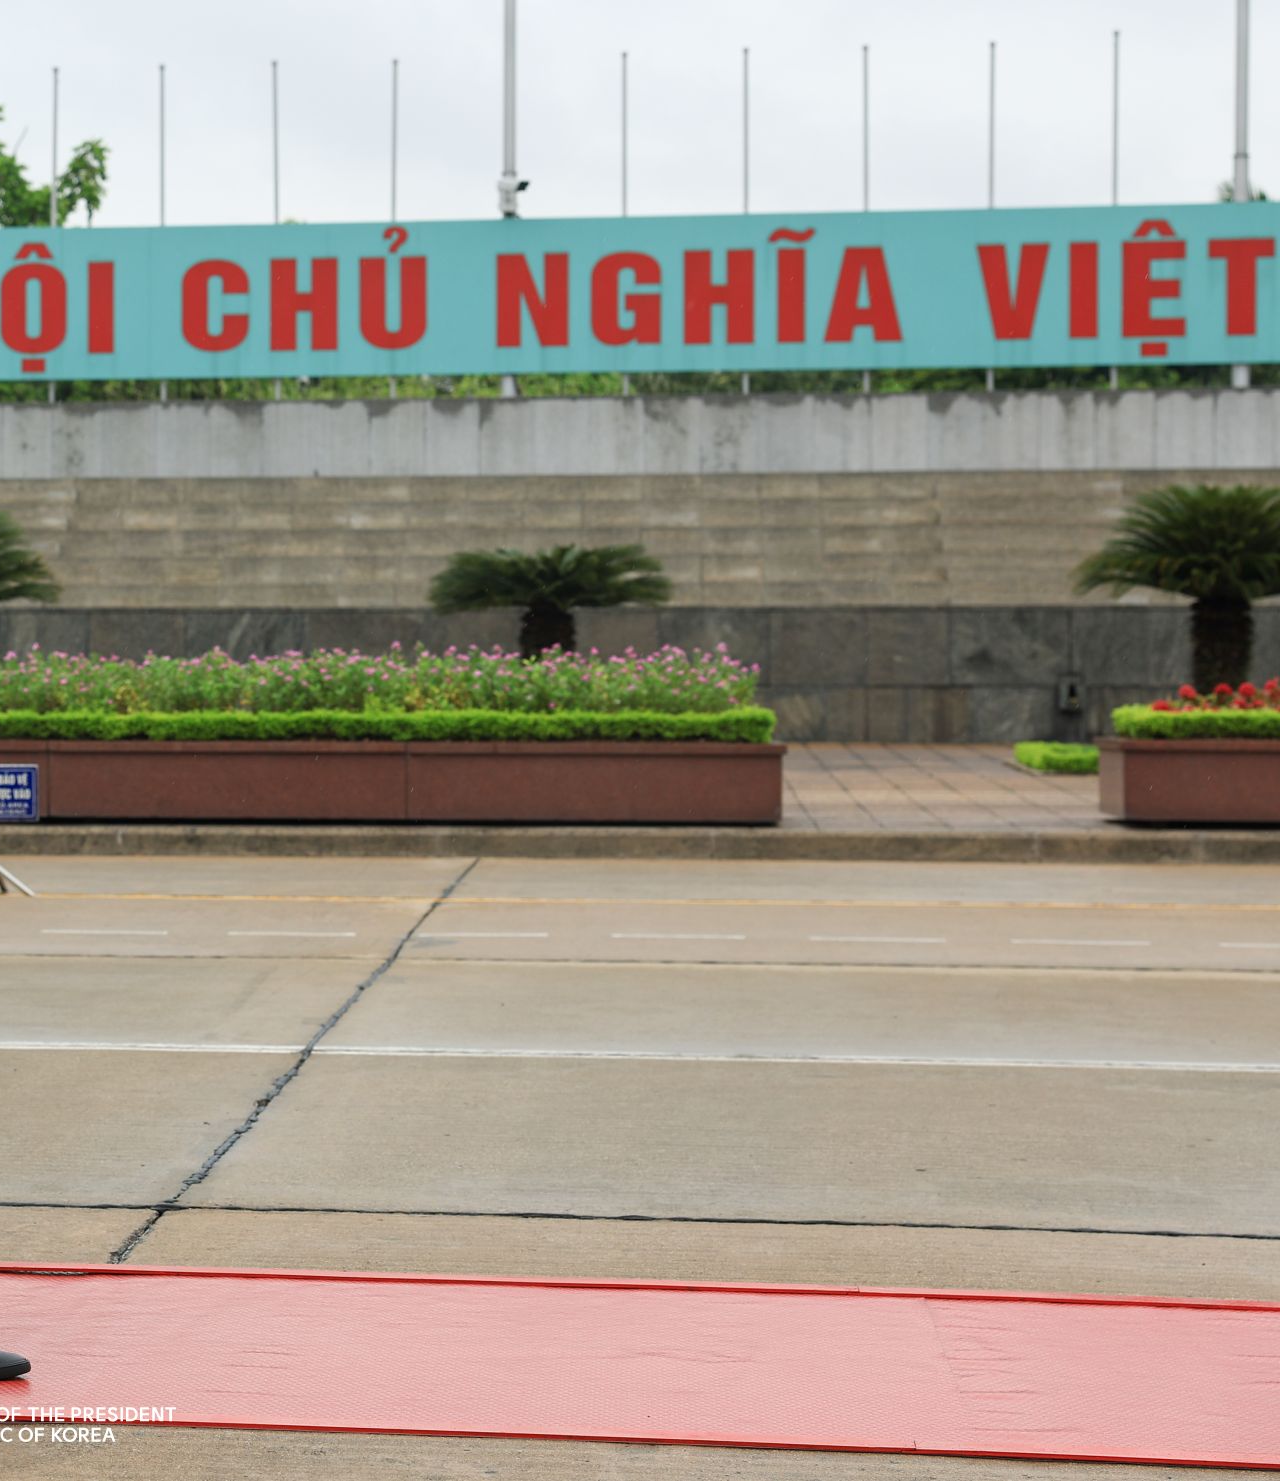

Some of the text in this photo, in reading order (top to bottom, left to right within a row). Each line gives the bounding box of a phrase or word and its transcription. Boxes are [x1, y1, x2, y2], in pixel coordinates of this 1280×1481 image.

[181, 226, 428, 352] CHỦ
[495, 228, 903, 347] NGHĨA
[977, 219, 1276, 357] VIỆT
